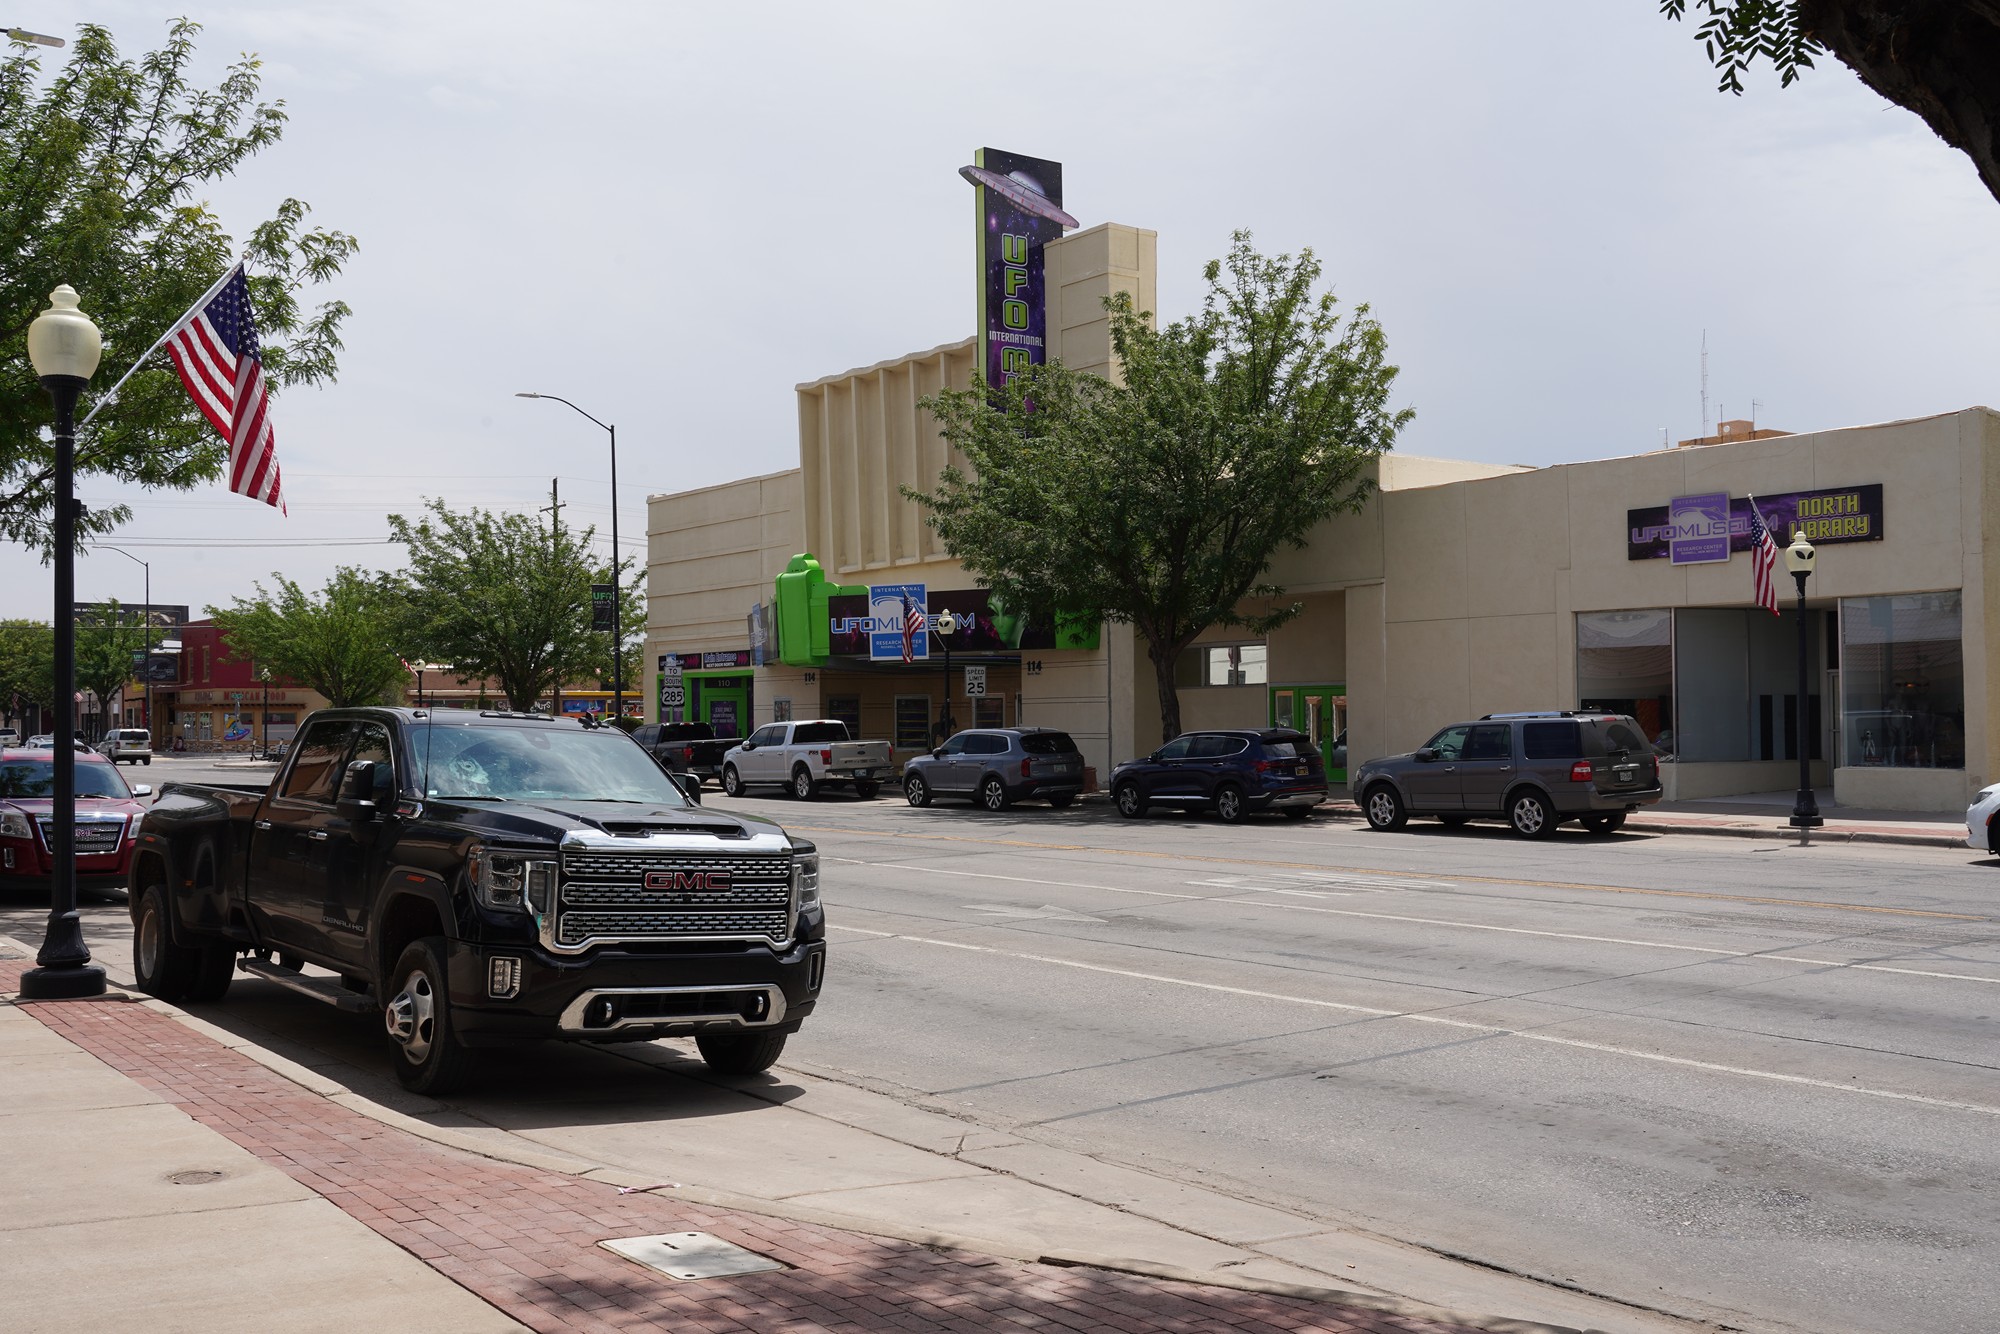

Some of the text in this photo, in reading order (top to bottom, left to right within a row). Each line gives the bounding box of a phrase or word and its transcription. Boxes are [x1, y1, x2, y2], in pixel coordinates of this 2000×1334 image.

[1002, 233, 1029, 330] UFO
[989, 331, 1044, 347] INTERNATIONAL
[1675, 496, 1722, 505] INTERNATIONAL
[1798, 493, 1859, 518] NORTH
[1789, 514, 1869, 541] LIBRARY
[1026, 661, 1042, 671] 114
[967, 682, 985, 694] 25
[664, 691, 683, 702] 285
[645, 871, 731, 890] GMC
[323, 916, 364, 932] DENALI HD
